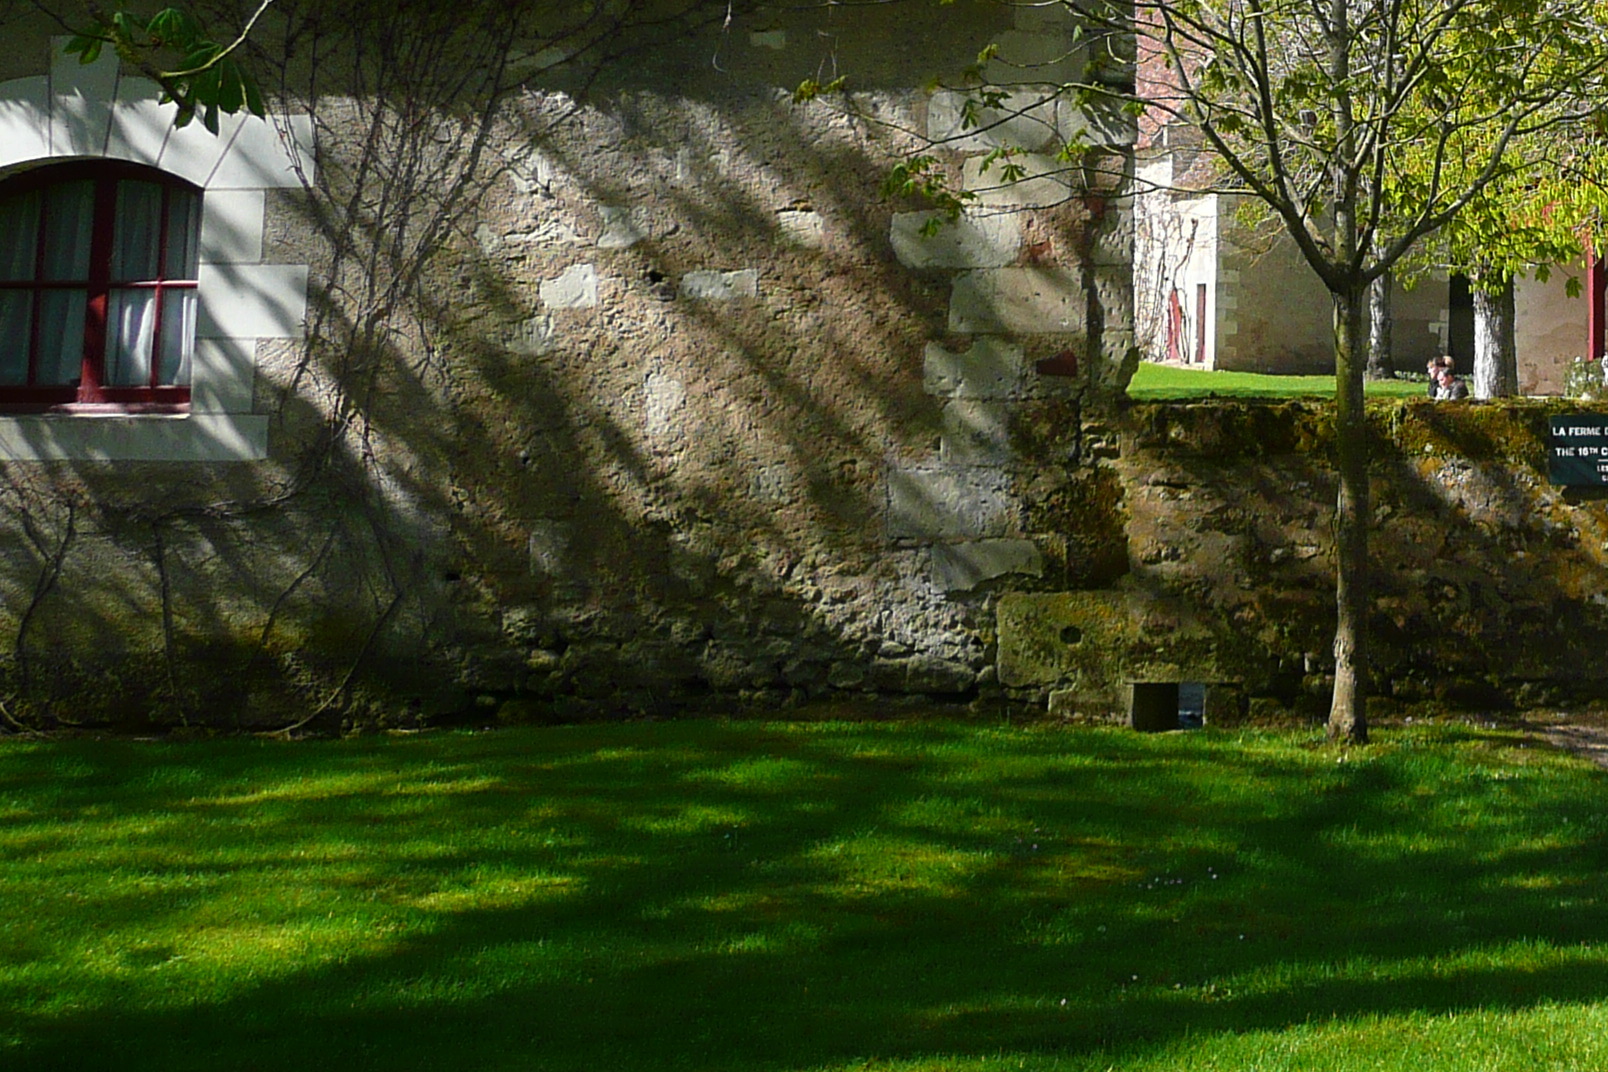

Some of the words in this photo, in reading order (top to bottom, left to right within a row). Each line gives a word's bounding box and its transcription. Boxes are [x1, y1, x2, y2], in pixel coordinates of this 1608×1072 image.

[1552, 426, 1566, 436] LA
[1569, 426, 1601, 436] FERME
[1555, 447, 1575, 457] THE
